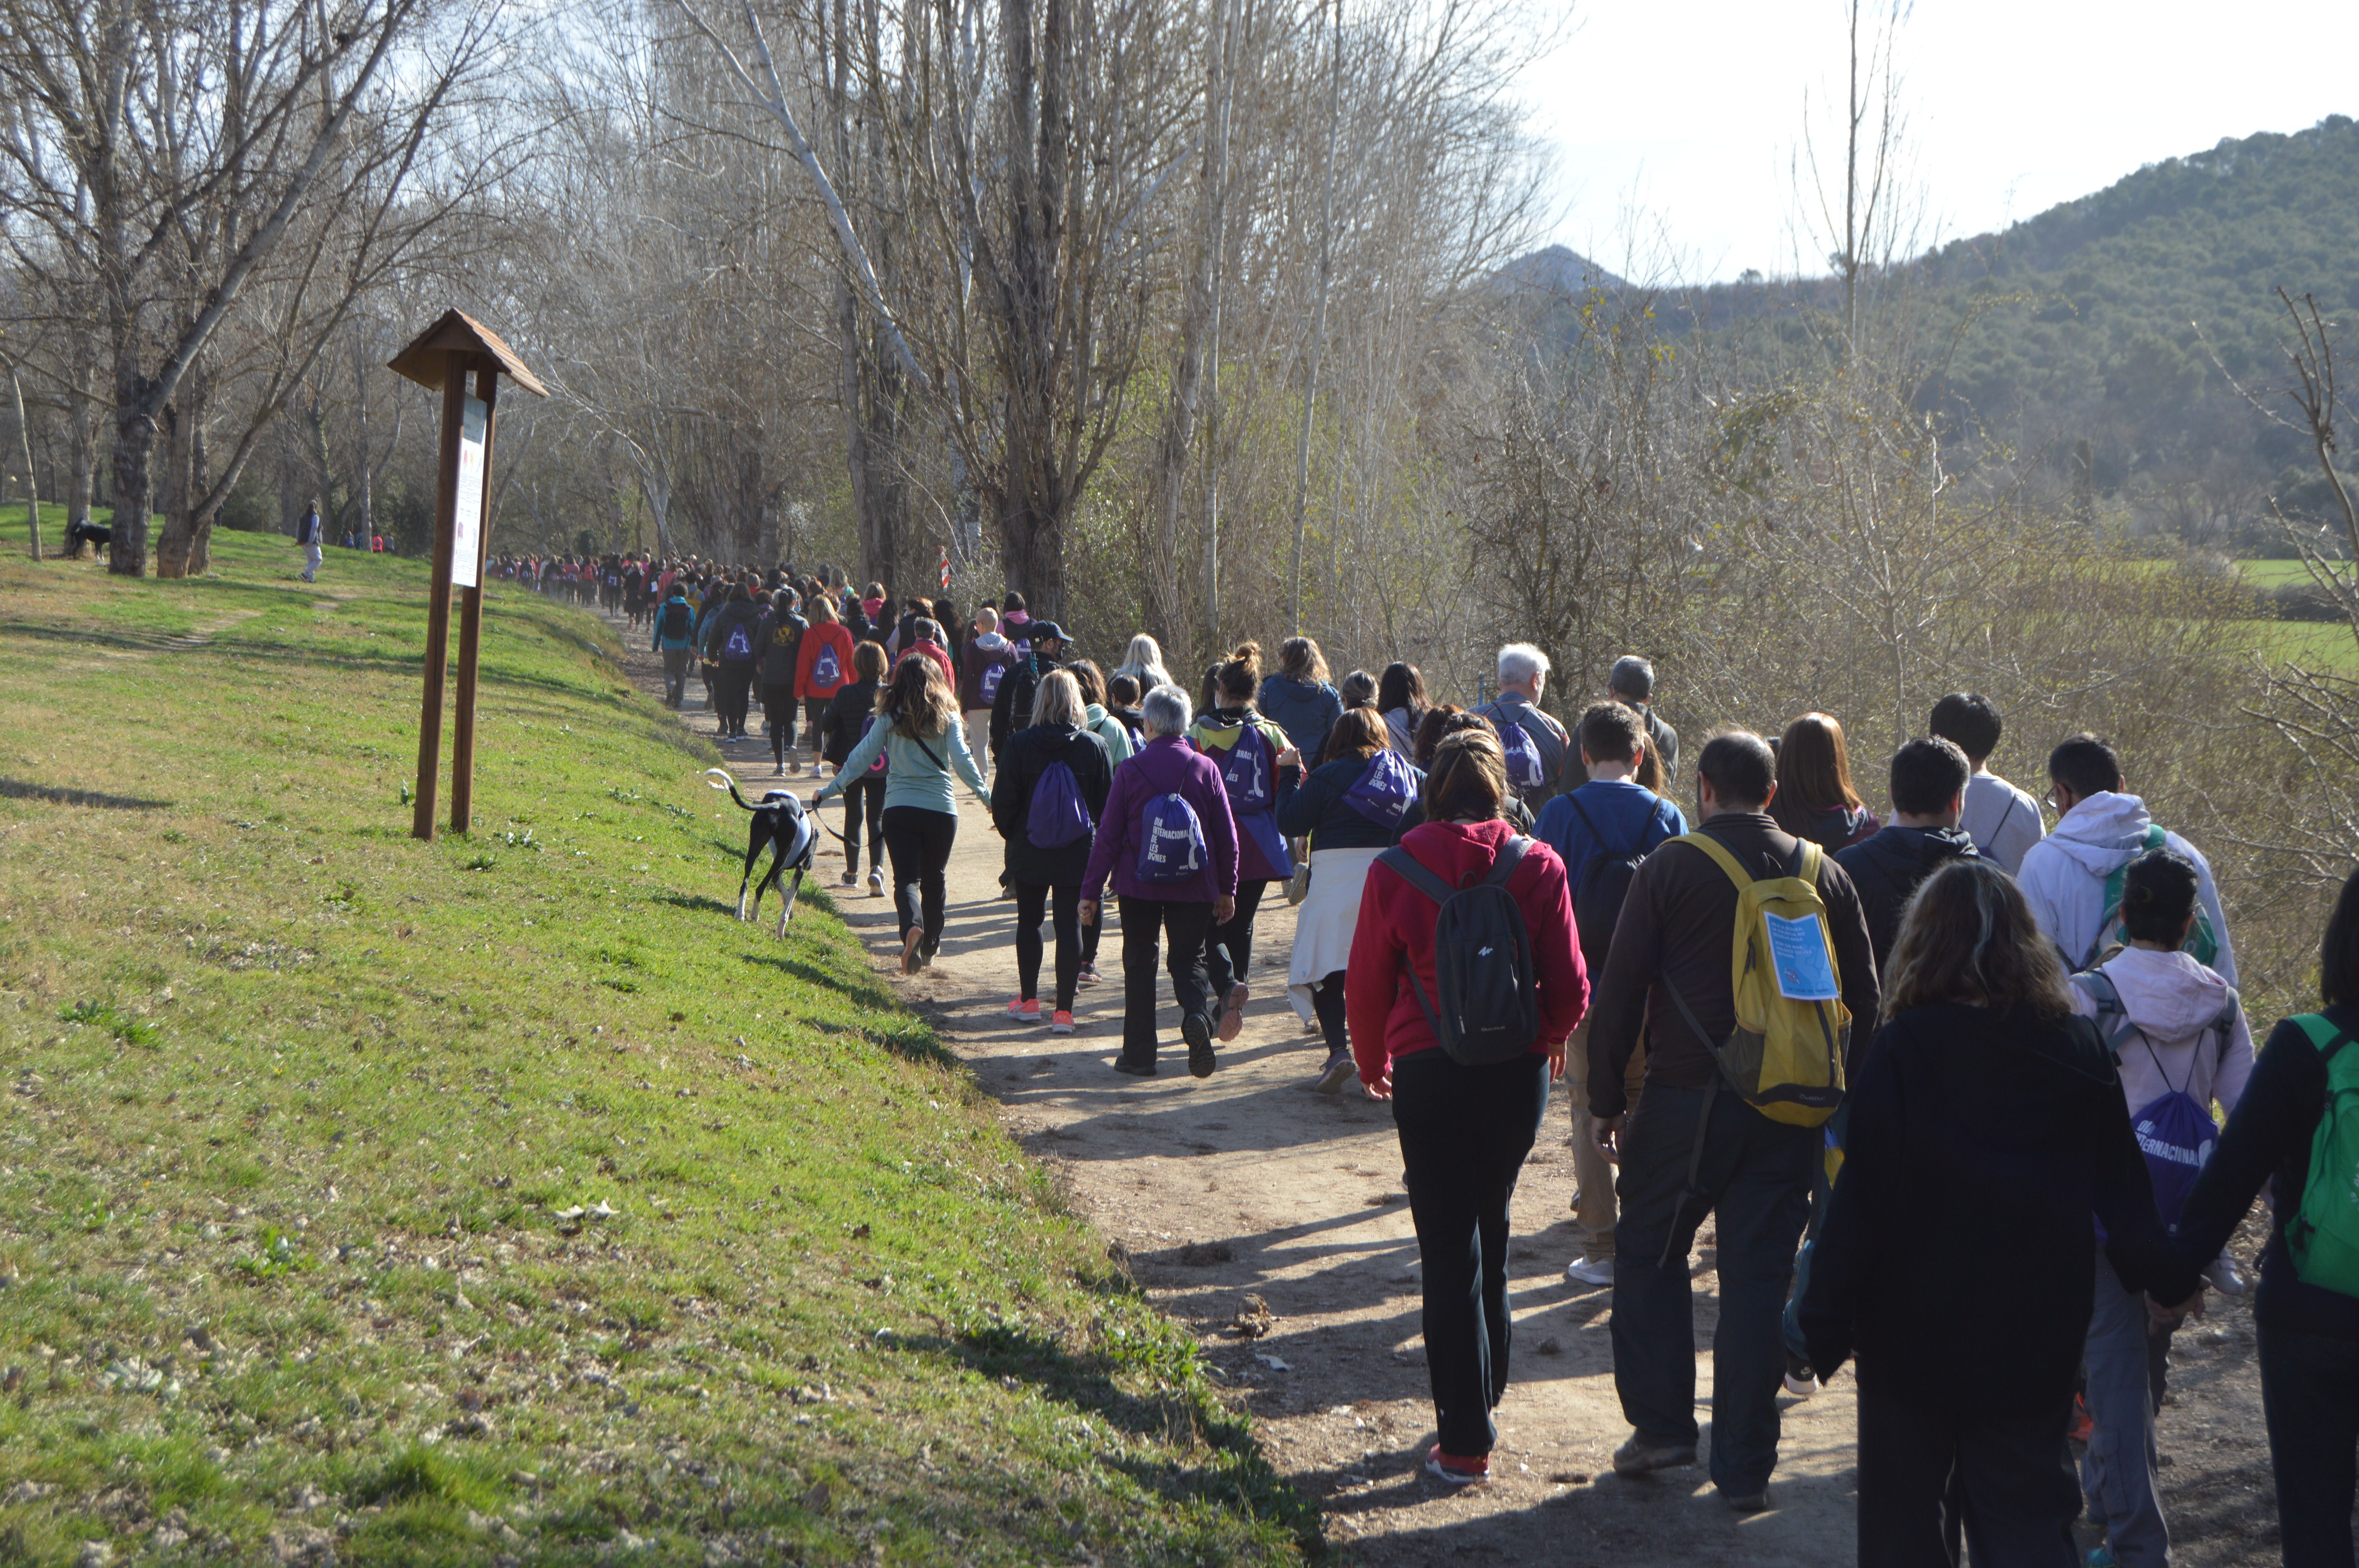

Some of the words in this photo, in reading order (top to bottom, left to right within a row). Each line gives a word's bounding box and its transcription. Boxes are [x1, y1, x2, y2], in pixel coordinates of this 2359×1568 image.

[1377, 761, 1387, 771] DE
[1373, 769, 1384, 780] LES
[1369, 778, 1387, 791] DONES
[1154, 817, 1163, 828] DIA
[1152, 826, 1189, 840] INTERNACIONAL
[1150, 834, 1158, 844] DE
[1149, 843, 1159, 853] LES
[1147, 851, 1166, 863] DONES
[2136, 1120, 2156, 1136] DIA
[2135, 1132, 2200, 1167] NTERNACIONAL
